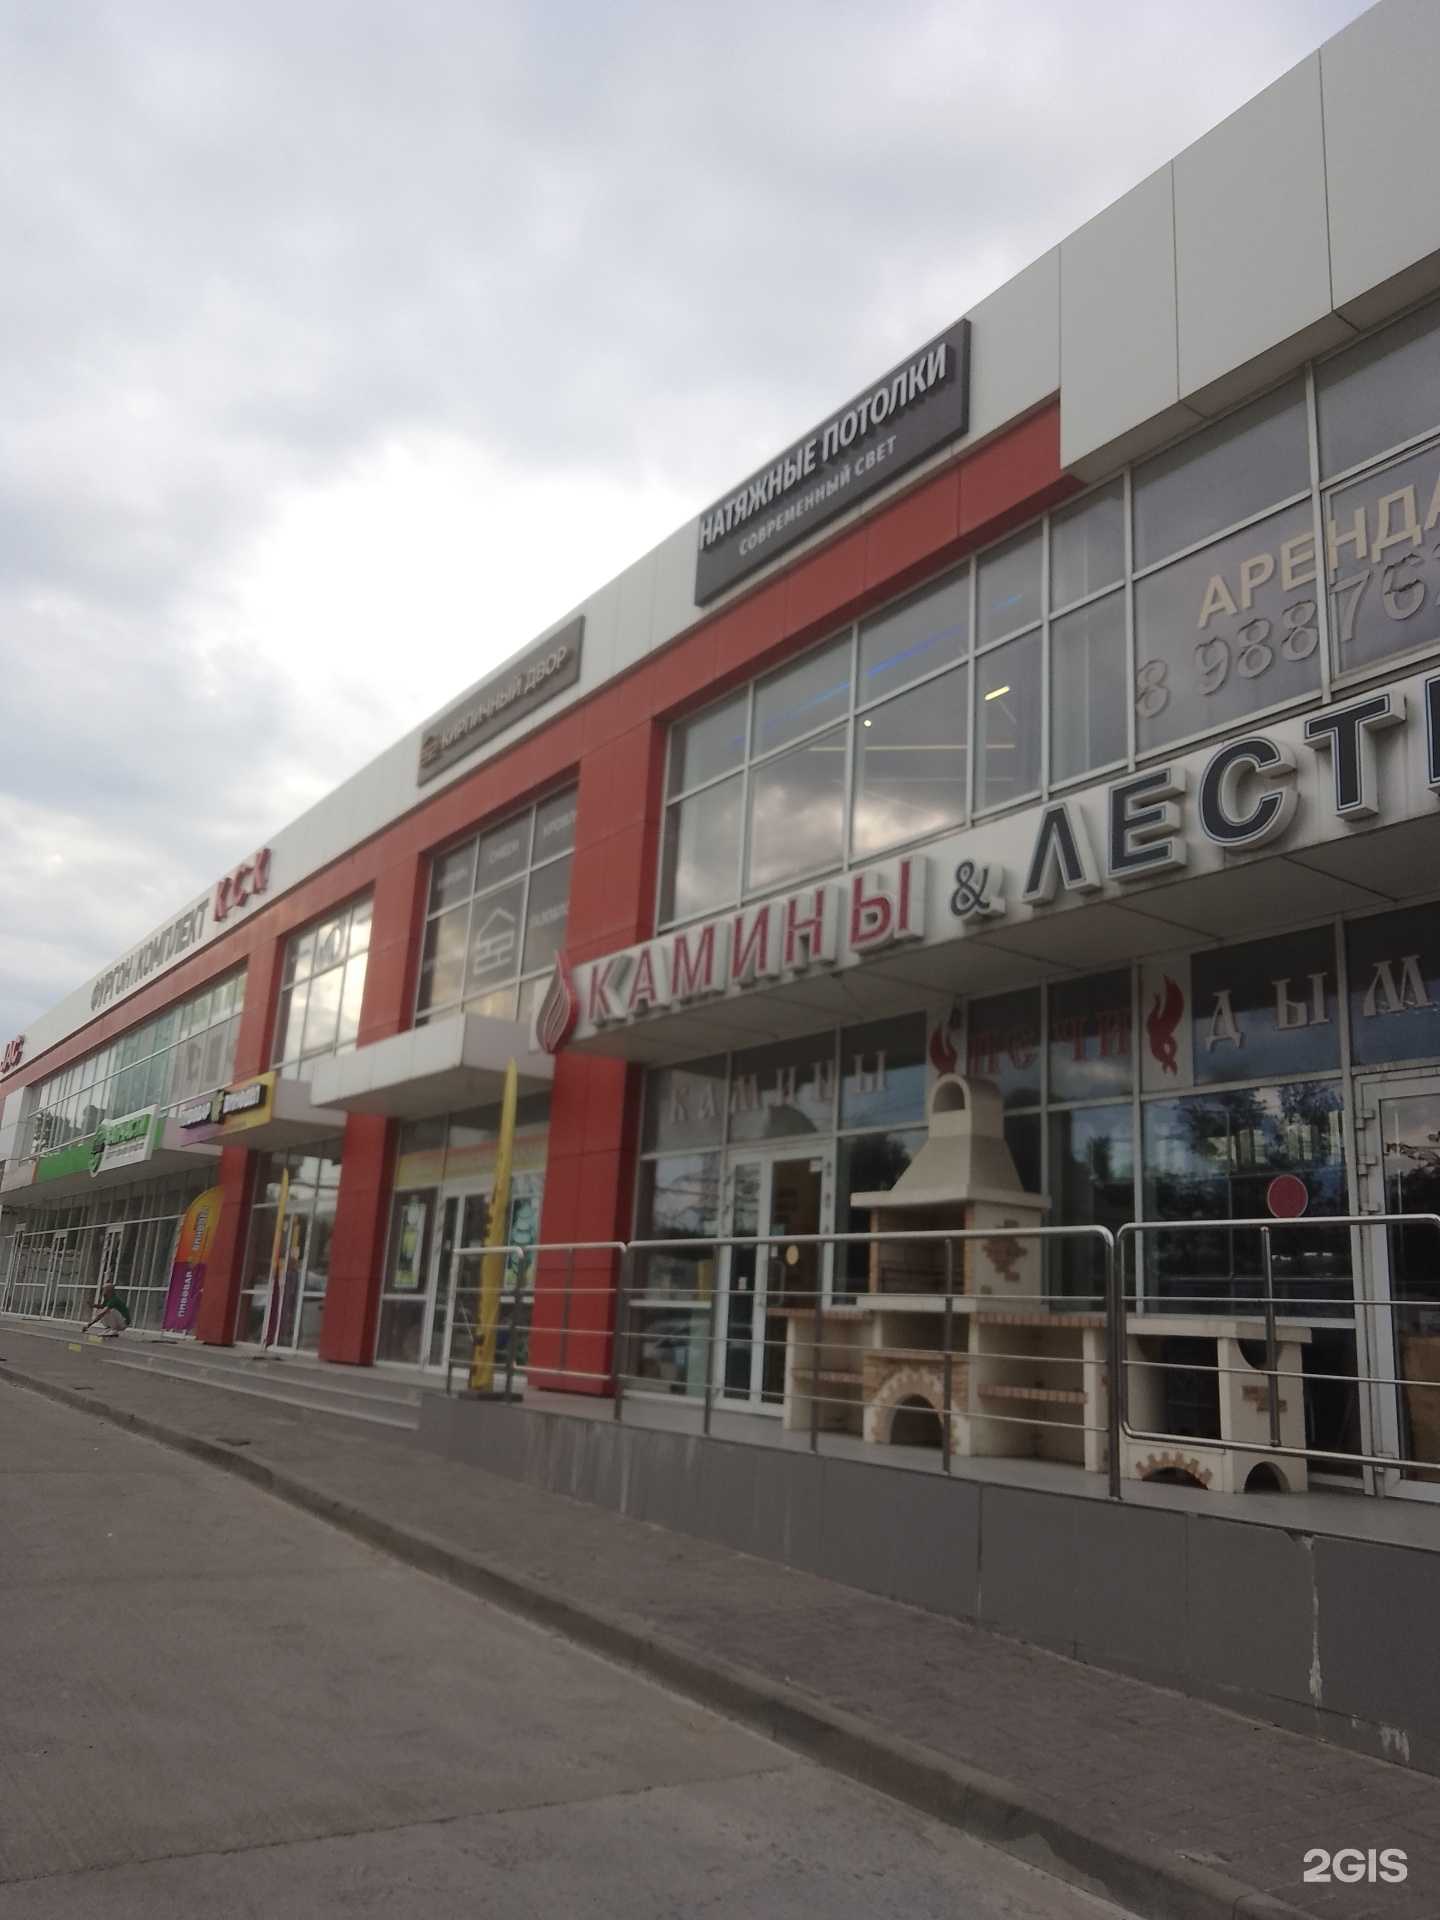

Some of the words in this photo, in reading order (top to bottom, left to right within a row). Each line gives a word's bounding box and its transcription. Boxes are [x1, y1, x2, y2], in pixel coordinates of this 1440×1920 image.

[700, 438, 817, 548] НАТЯЖНЫЕ
[821, 342, 947, 463] ПОТОЛКИ
[739, 465, 850, 556] СОВРЕМЕННЫЙ
[854, 435, 897, 477] СВЕТ
[440, 676, 523, 750] КИРПИЧНЫЙ
[524, 645, 568, 695] ДВОР
[1135, 658, 1170, 719] 8
[1195, 541, 1440, 696] 98876
[589, 856, 912, 1026] КАМИНЫ
[950, 860, 995, 919] &
